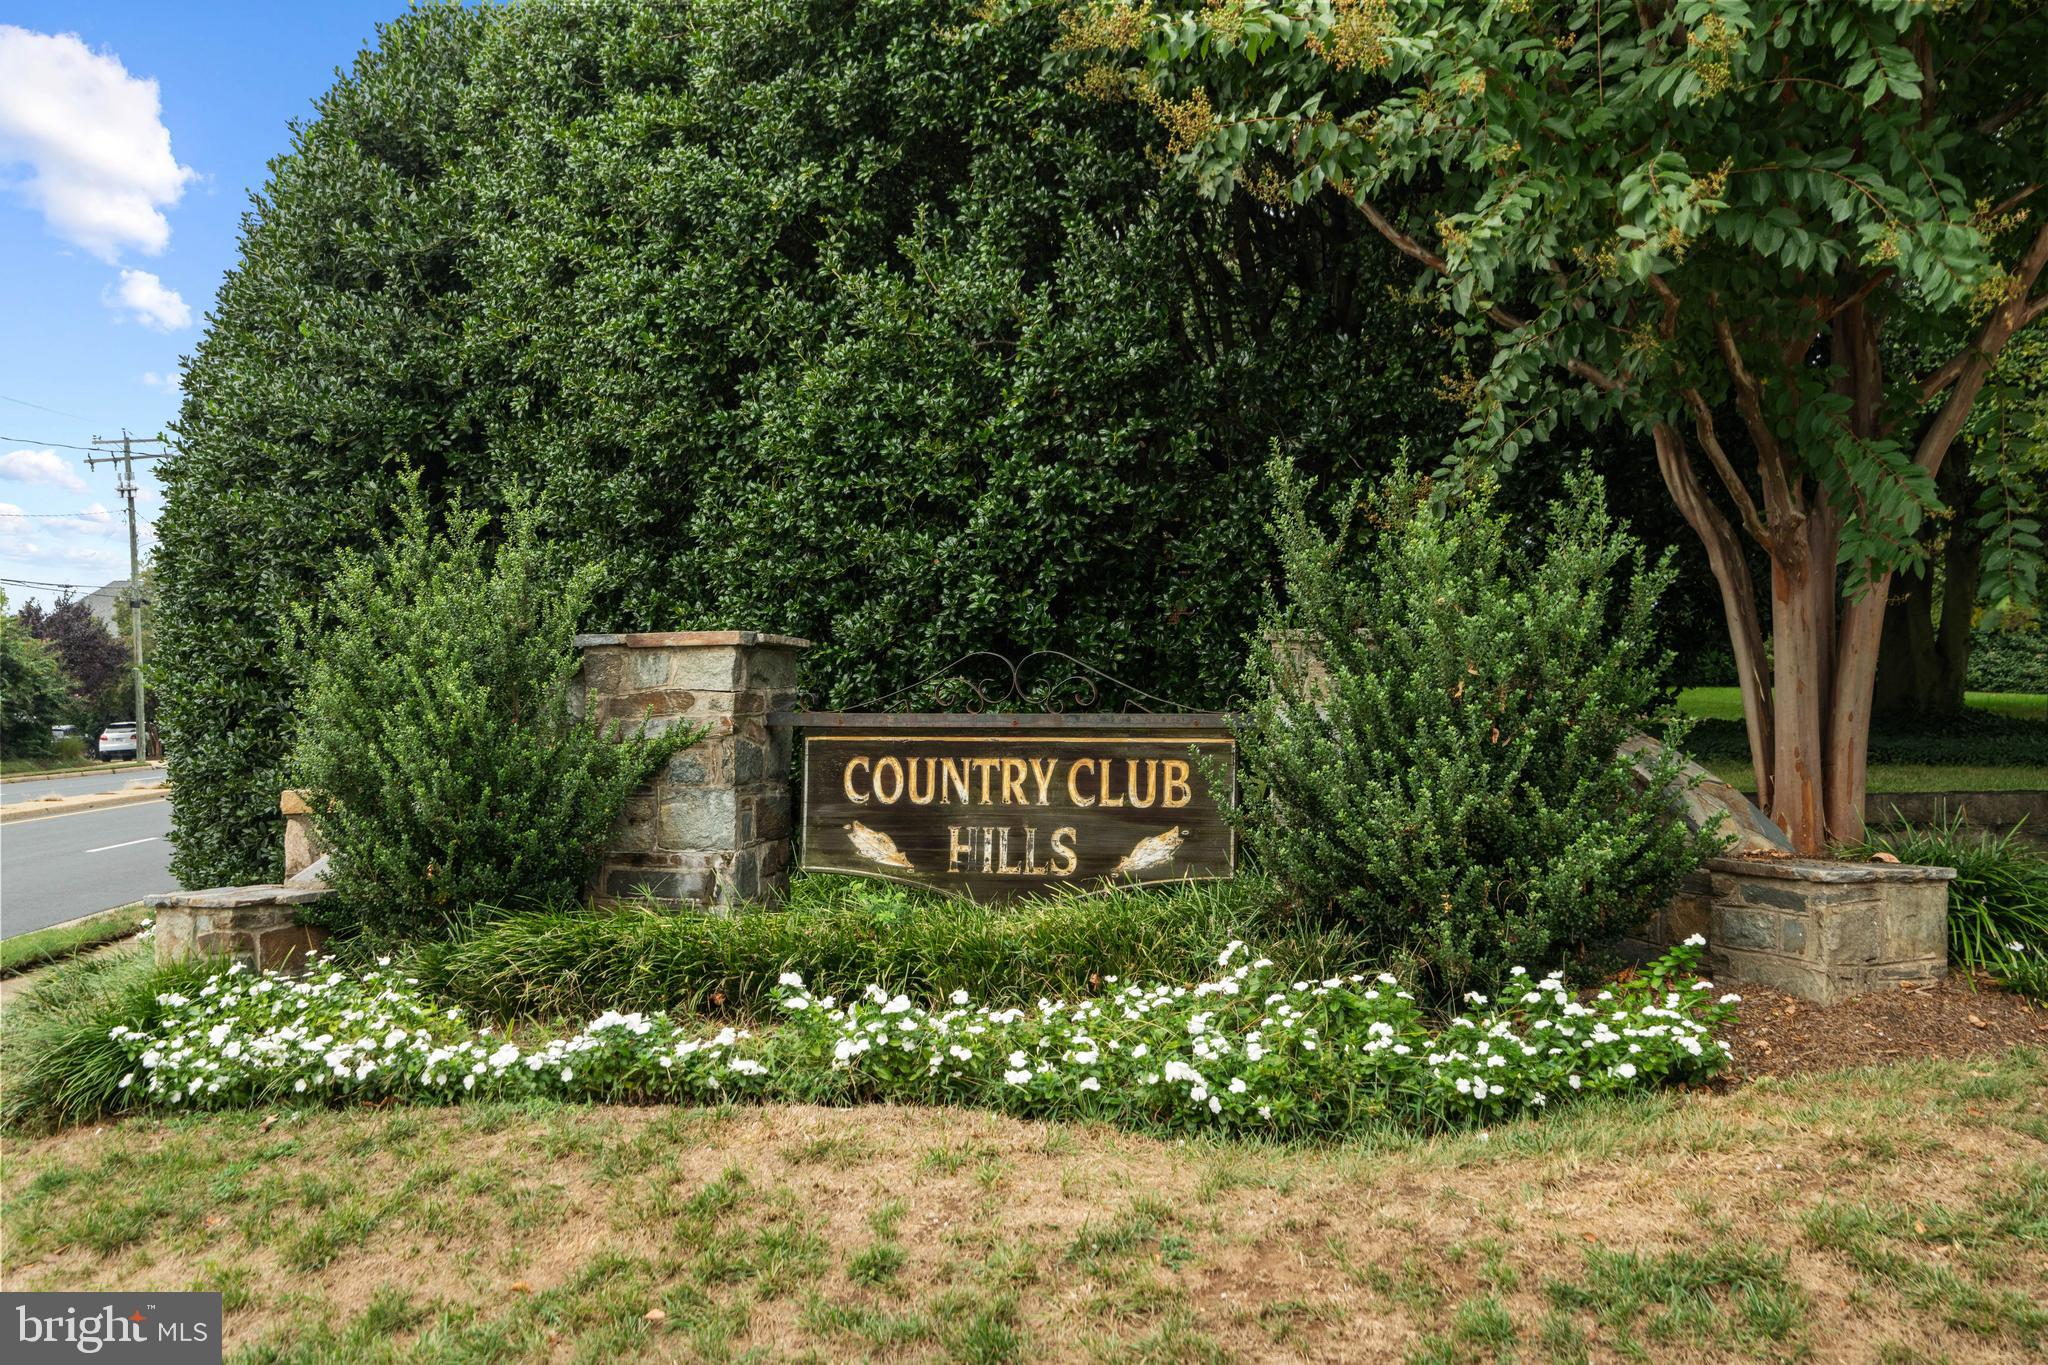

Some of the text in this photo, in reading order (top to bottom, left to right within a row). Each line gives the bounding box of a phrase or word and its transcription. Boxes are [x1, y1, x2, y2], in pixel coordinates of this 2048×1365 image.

[843, 756, 1192, 808] COUNTRY CLUB
[947, 826, 1077, 876] HILLS
